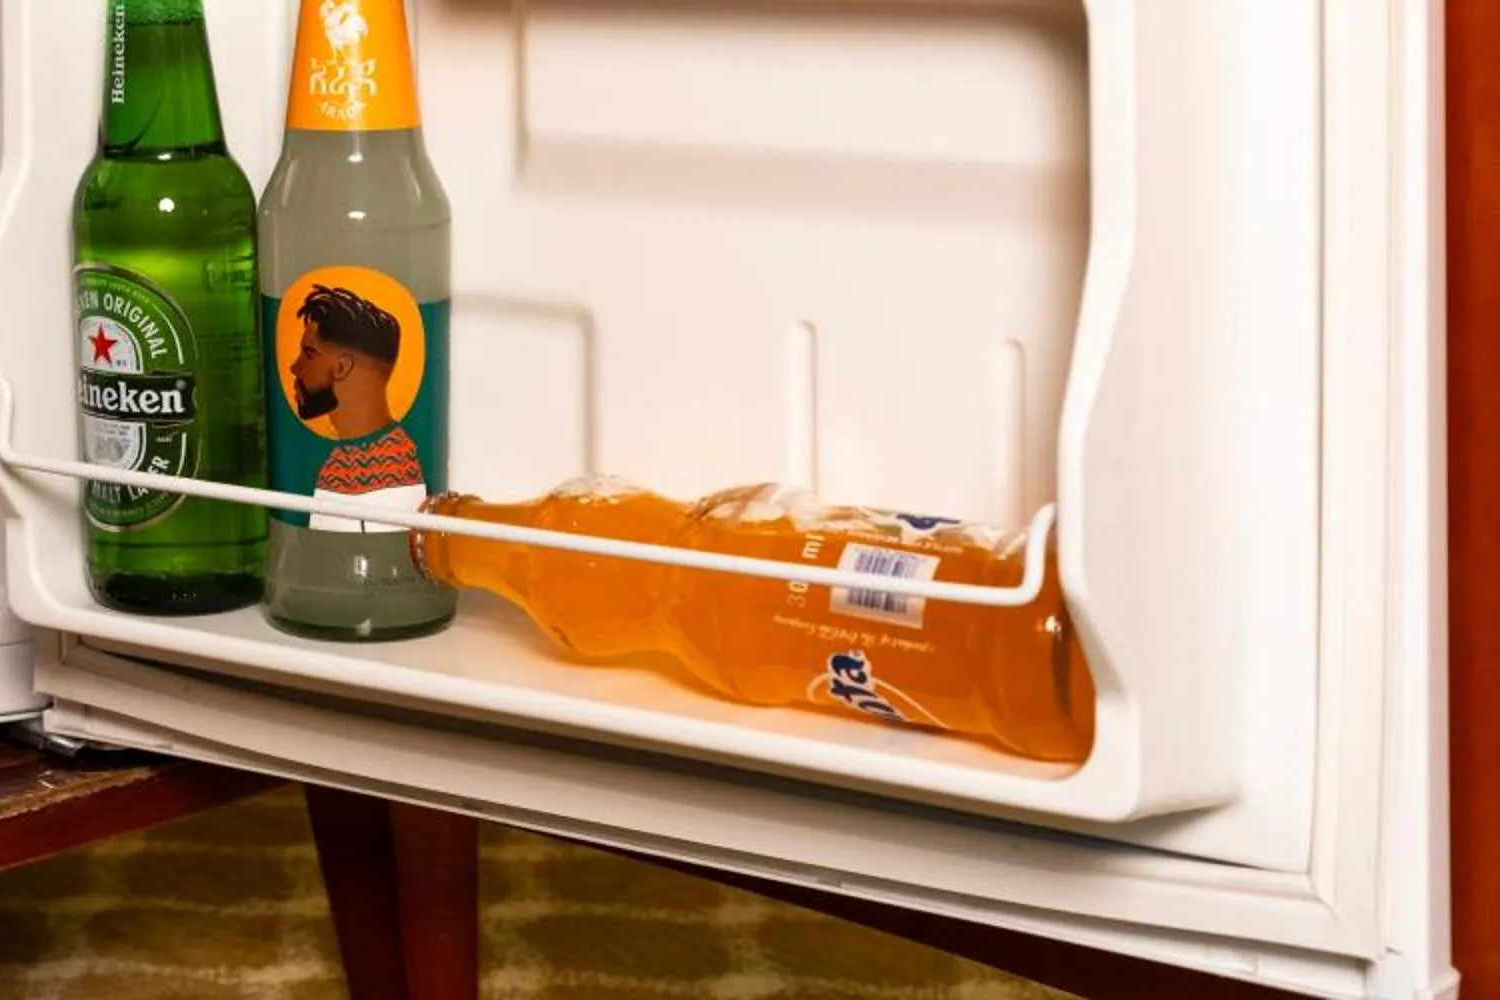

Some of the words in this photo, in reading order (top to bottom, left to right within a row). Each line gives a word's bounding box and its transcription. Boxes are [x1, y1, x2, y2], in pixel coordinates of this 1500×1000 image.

[111, 3, 125, 104] Heineken
[103, 293, 168, 359] ORIGINAL
[802, 534, 825, 560] ml
